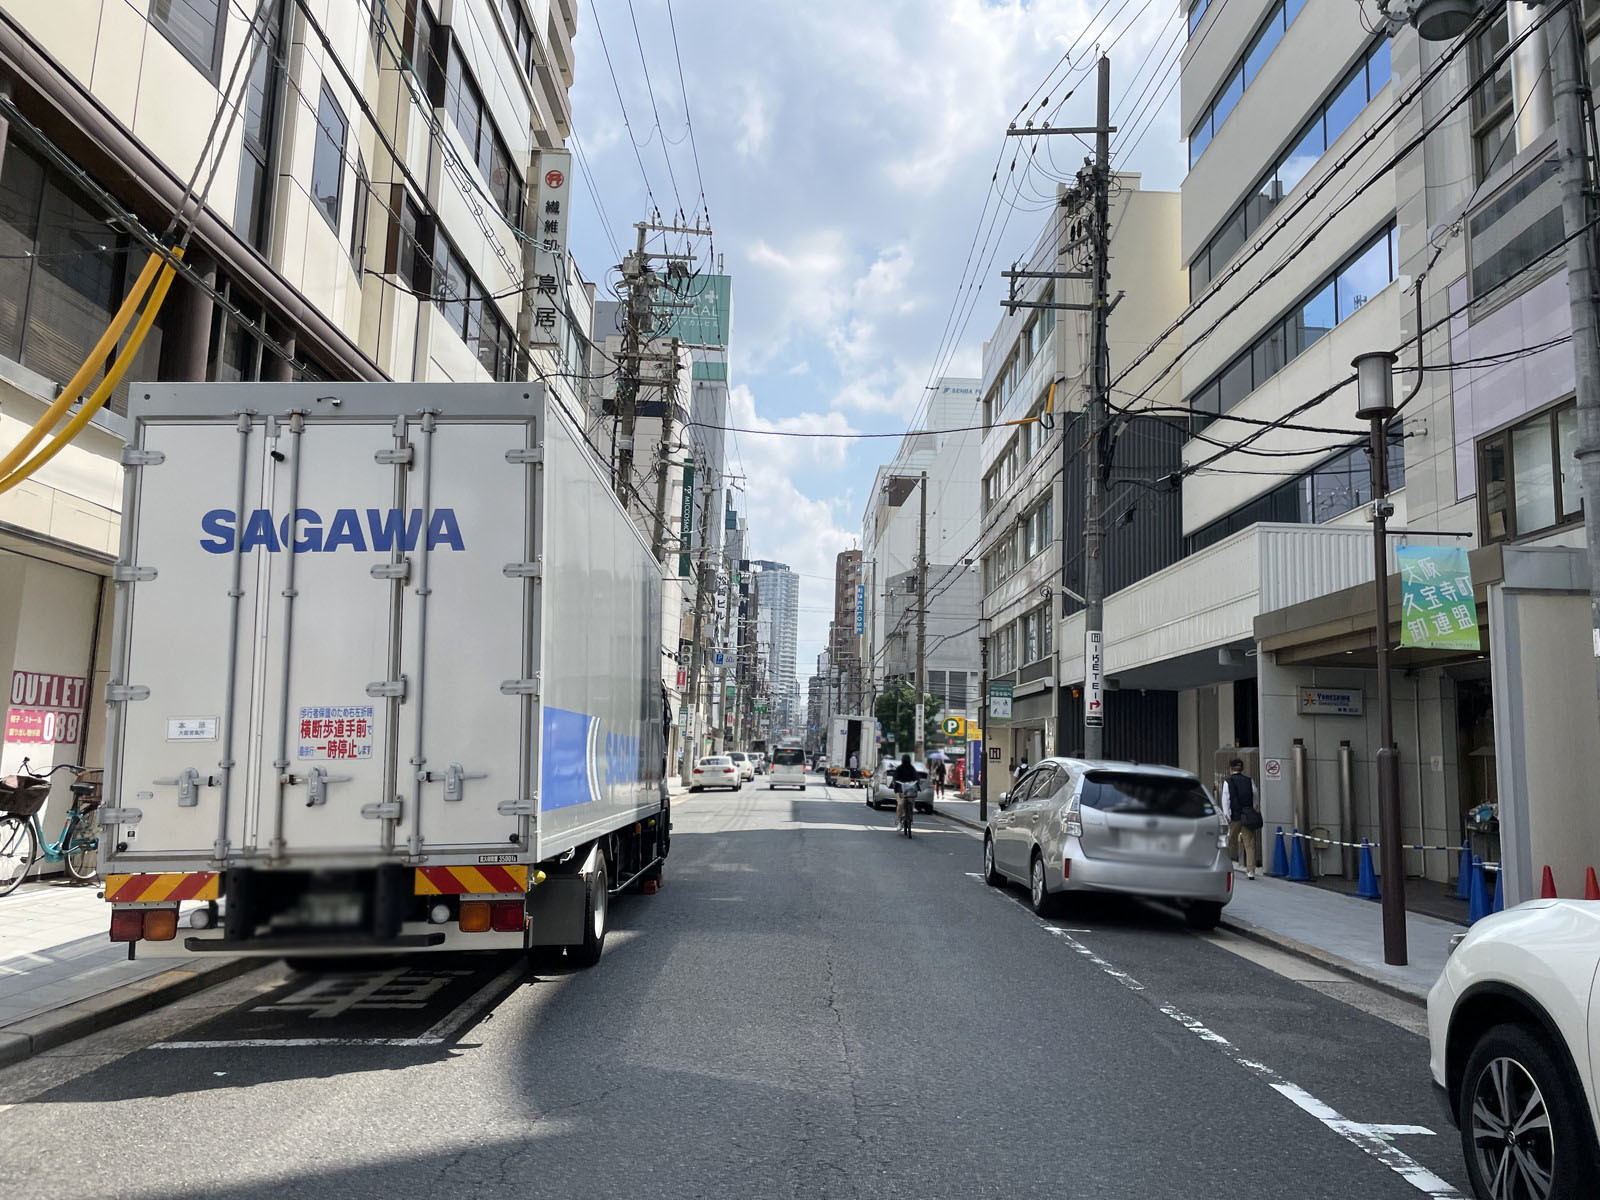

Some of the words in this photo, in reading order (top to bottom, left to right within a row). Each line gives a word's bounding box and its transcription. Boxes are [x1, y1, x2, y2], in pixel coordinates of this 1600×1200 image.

[200, 508, 465, 554] SAGAWA
[1402, 557, 1441, 586] 大阪
[1403, 576, 1474, 617] 久宝寺町
[1407, 604, 1475, 643] 卸連盟
[12, 672, 84, 708] OUTLET
[300, 719, 373, 739] 横断歩道手前で
[947, 720, 958, 733] P
